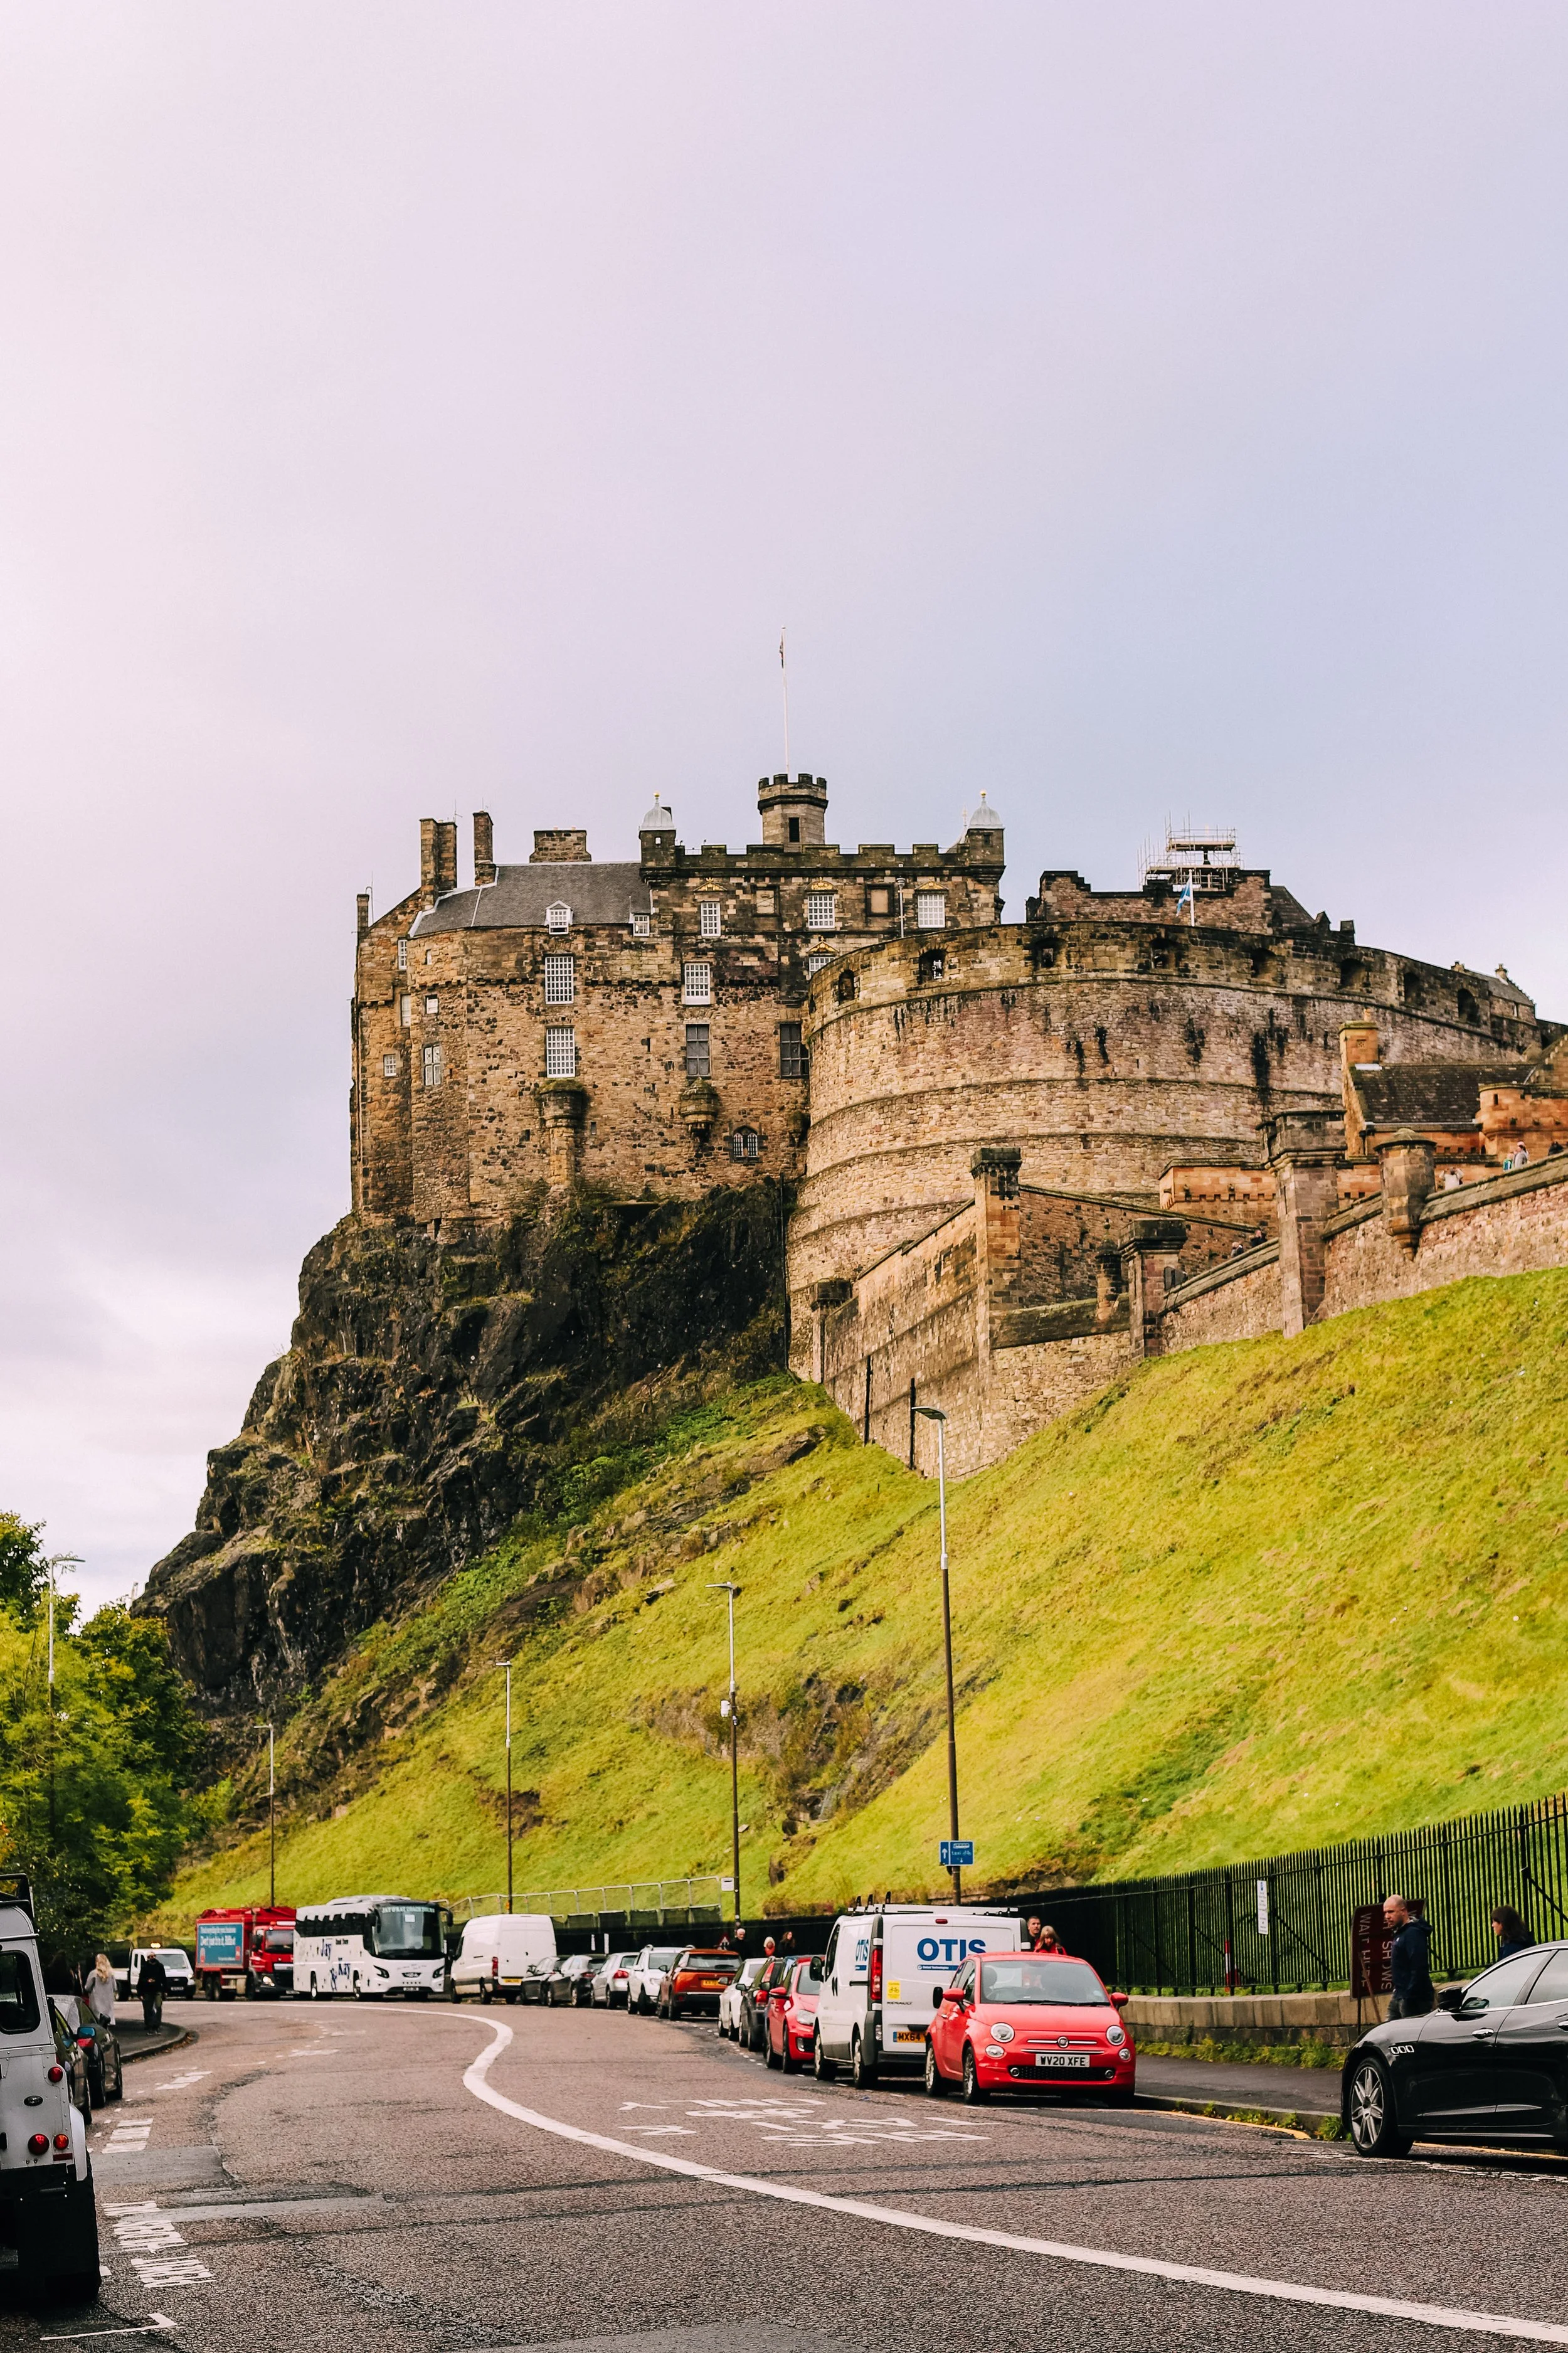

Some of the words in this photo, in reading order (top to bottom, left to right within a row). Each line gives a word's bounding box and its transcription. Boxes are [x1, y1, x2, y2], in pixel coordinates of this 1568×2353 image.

[855, 1939, 869, 1962] OTIS
[917, 1938, 986, 1962] OTIS
[898, 2032, 921, 2041] MX64
[1041, 2056, 1065, 2066] WV20
[1067, 2057, 1086, 2066] XFE
[618, 2098, 827, 2110] ONLY
[751, 2117, 1000, 2131] TAXI
[761, 2130, 992, 2147] BUS
